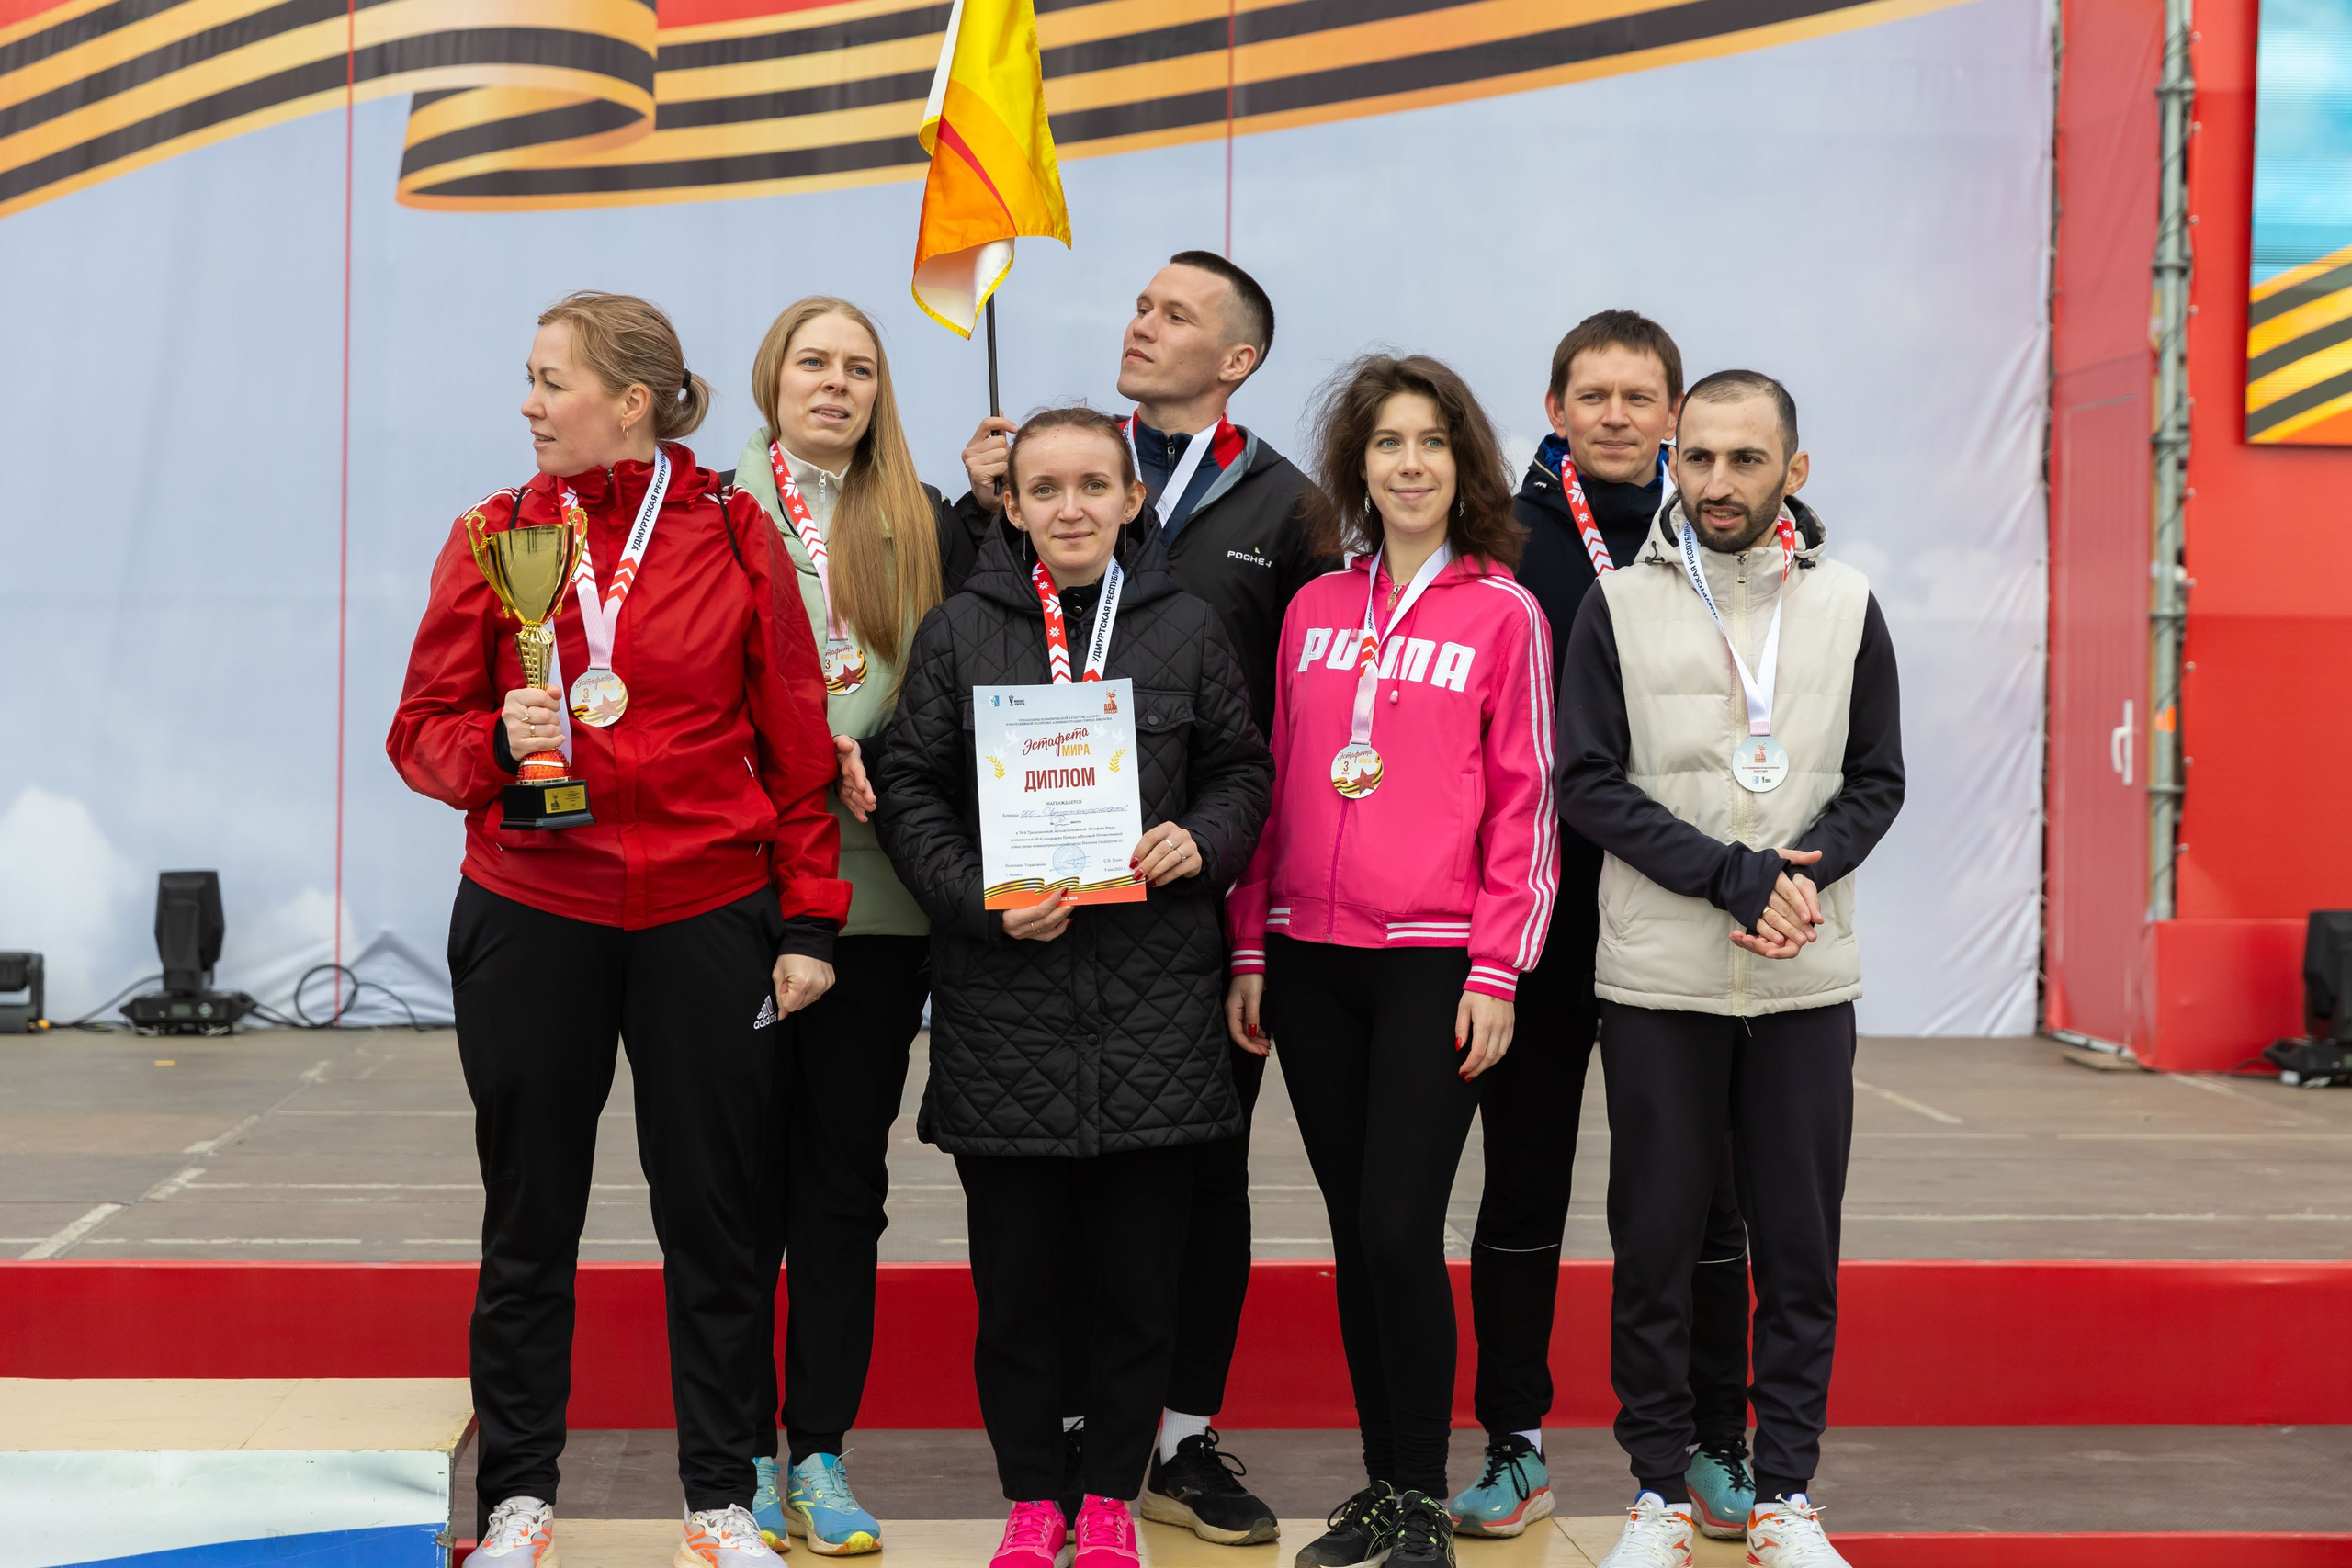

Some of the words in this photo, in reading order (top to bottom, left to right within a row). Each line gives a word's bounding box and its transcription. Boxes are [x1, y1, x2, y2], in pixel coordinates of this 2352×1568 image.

[631, 494, 658, 551] УДМУРТСКАЯ
[1091, 605, 1113, 662] УДМУРТСКАЯ
[824, 659, 831, 669] 3
[1297, 627, 1476, 693] PUMA
[582, 688, 589, 699] 3
[1022, 727, 1089, 757] Эстафета
[1061, 743, 1091, 757] МИРА
[1343, 761, 1350, 772] 3
[1024, 767, 1095, 792] ДИПЛОМ
[753, 1012, 777, 1029] adidas
